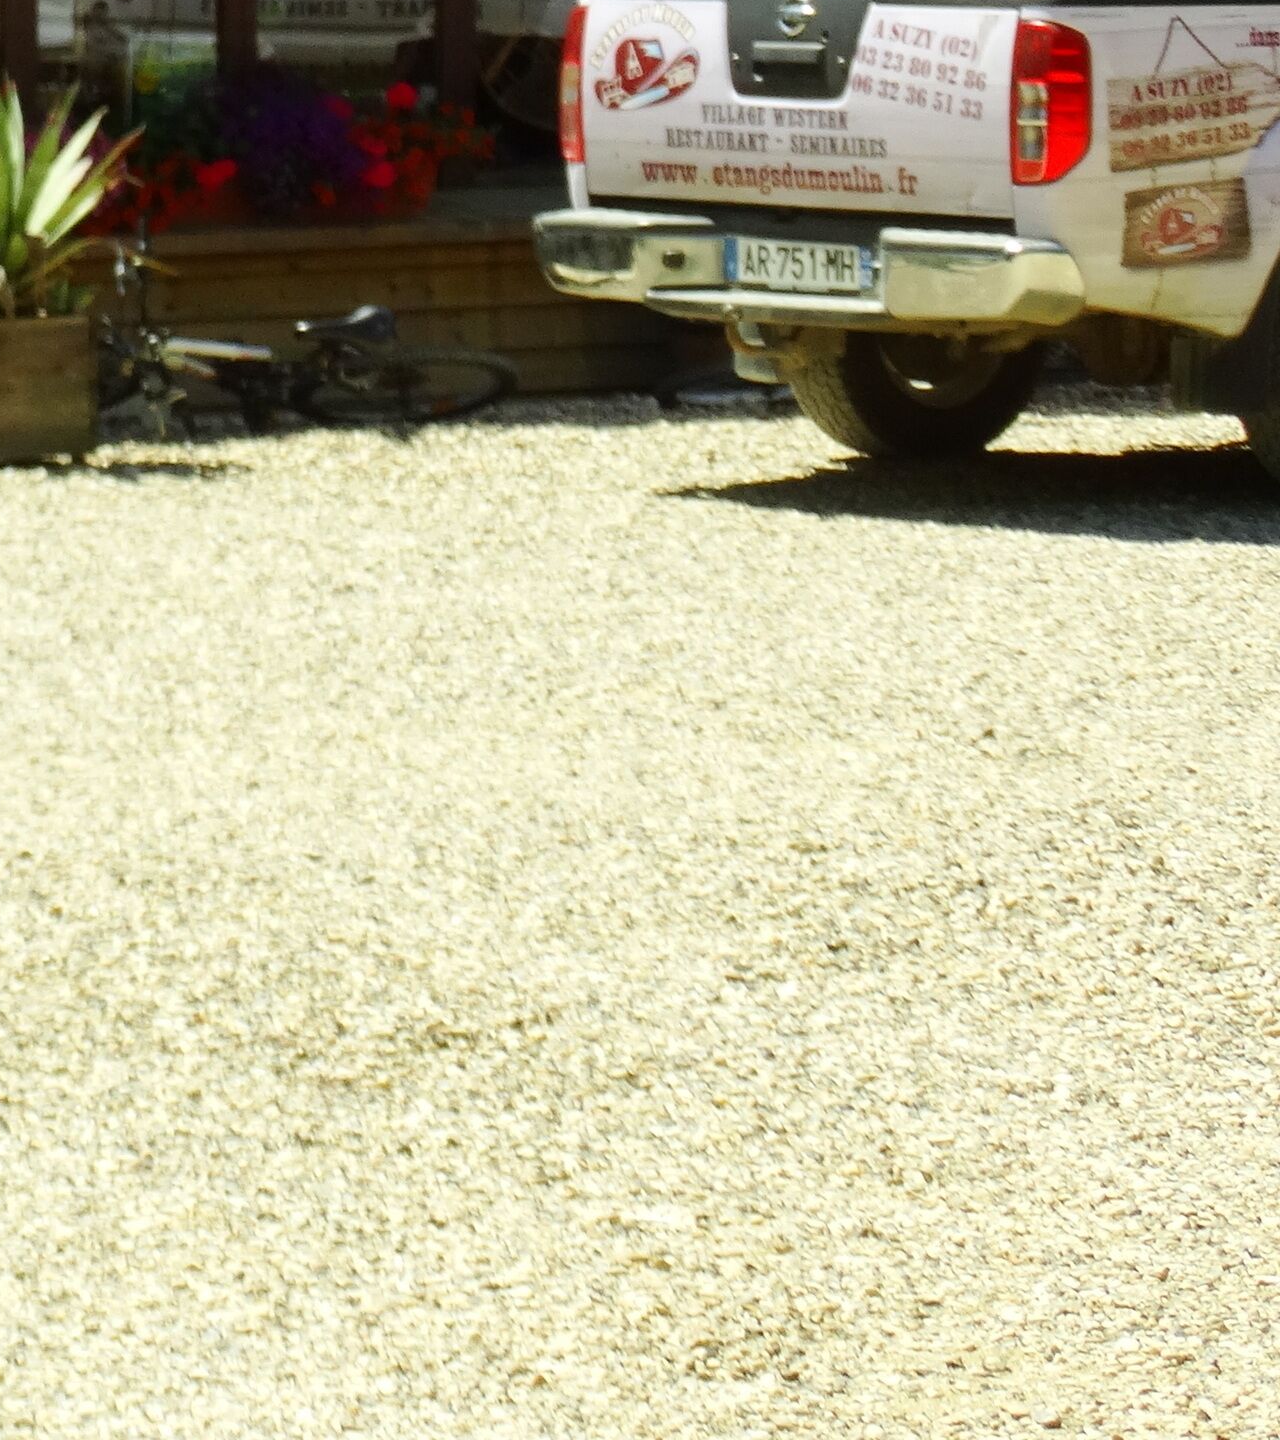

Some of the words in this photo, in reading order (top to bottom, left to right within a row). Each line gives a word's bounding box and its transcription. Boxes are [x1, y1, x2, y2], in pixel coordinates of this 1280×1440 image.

[701, 104, 766, 126] VILLAGE
[773, 108, 849, 131] WESTERN
[665, 127, 770, 152] RESTAURANT
[790, 134, 889, 159] SEMINAIRES
